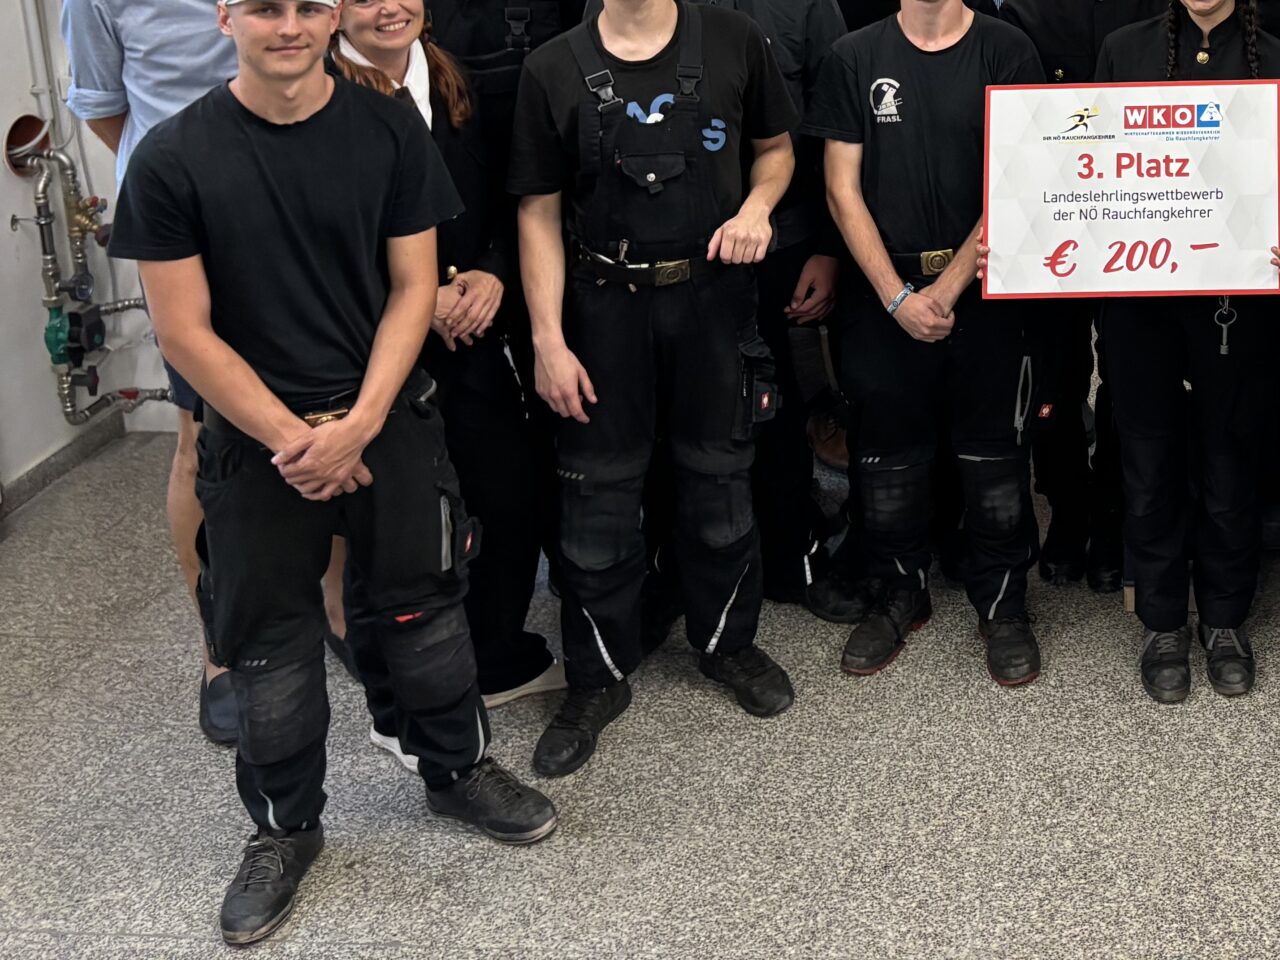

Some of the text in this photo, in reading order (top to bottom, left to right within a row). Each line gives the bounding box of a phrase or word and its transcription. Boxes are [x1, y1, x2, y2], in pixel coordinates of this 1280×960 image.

[876, 114, 903, 124] FRASL
[1124, 107, 1193, 127] WKO
[1077, 152, 1190, 180] 3. Platz
[1043, 188, 1224, 205] Landeslehrlingswettbewerb
[1053, 205, 1213, 222] der NÖ Rauchfangkehrer
[1043, 239, 1079, 278] €
